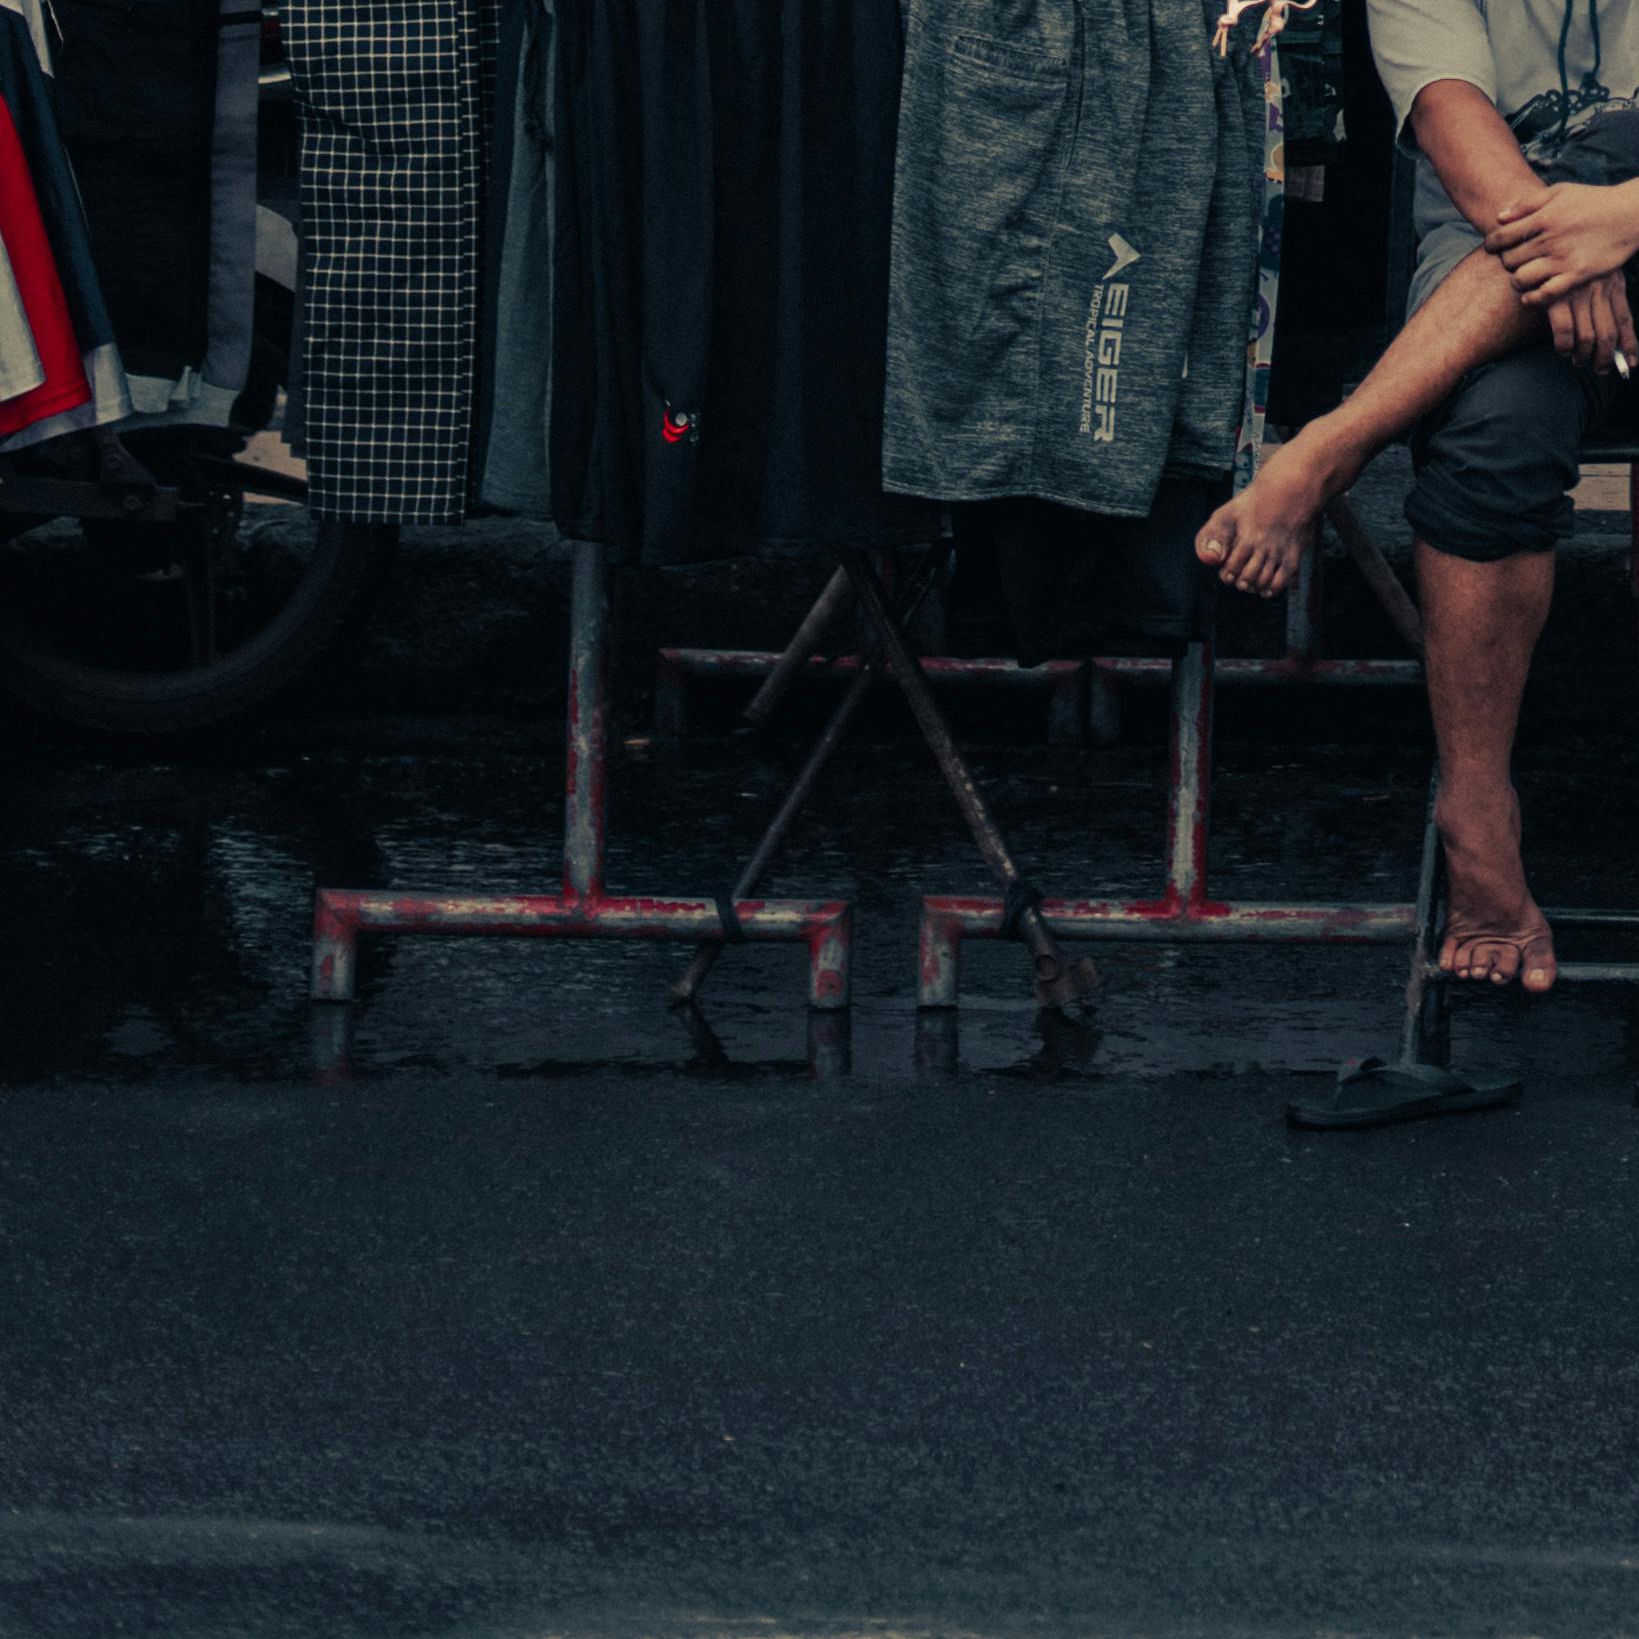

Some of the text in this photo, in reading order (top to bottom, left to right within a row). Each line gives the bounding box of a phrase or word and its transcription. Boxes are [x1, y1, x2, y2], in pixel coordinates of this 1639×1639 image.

[1080, 284, 1104, 434] TROPICAL ADVENTURE
[1094, 283, 1130, 442] EIGER
